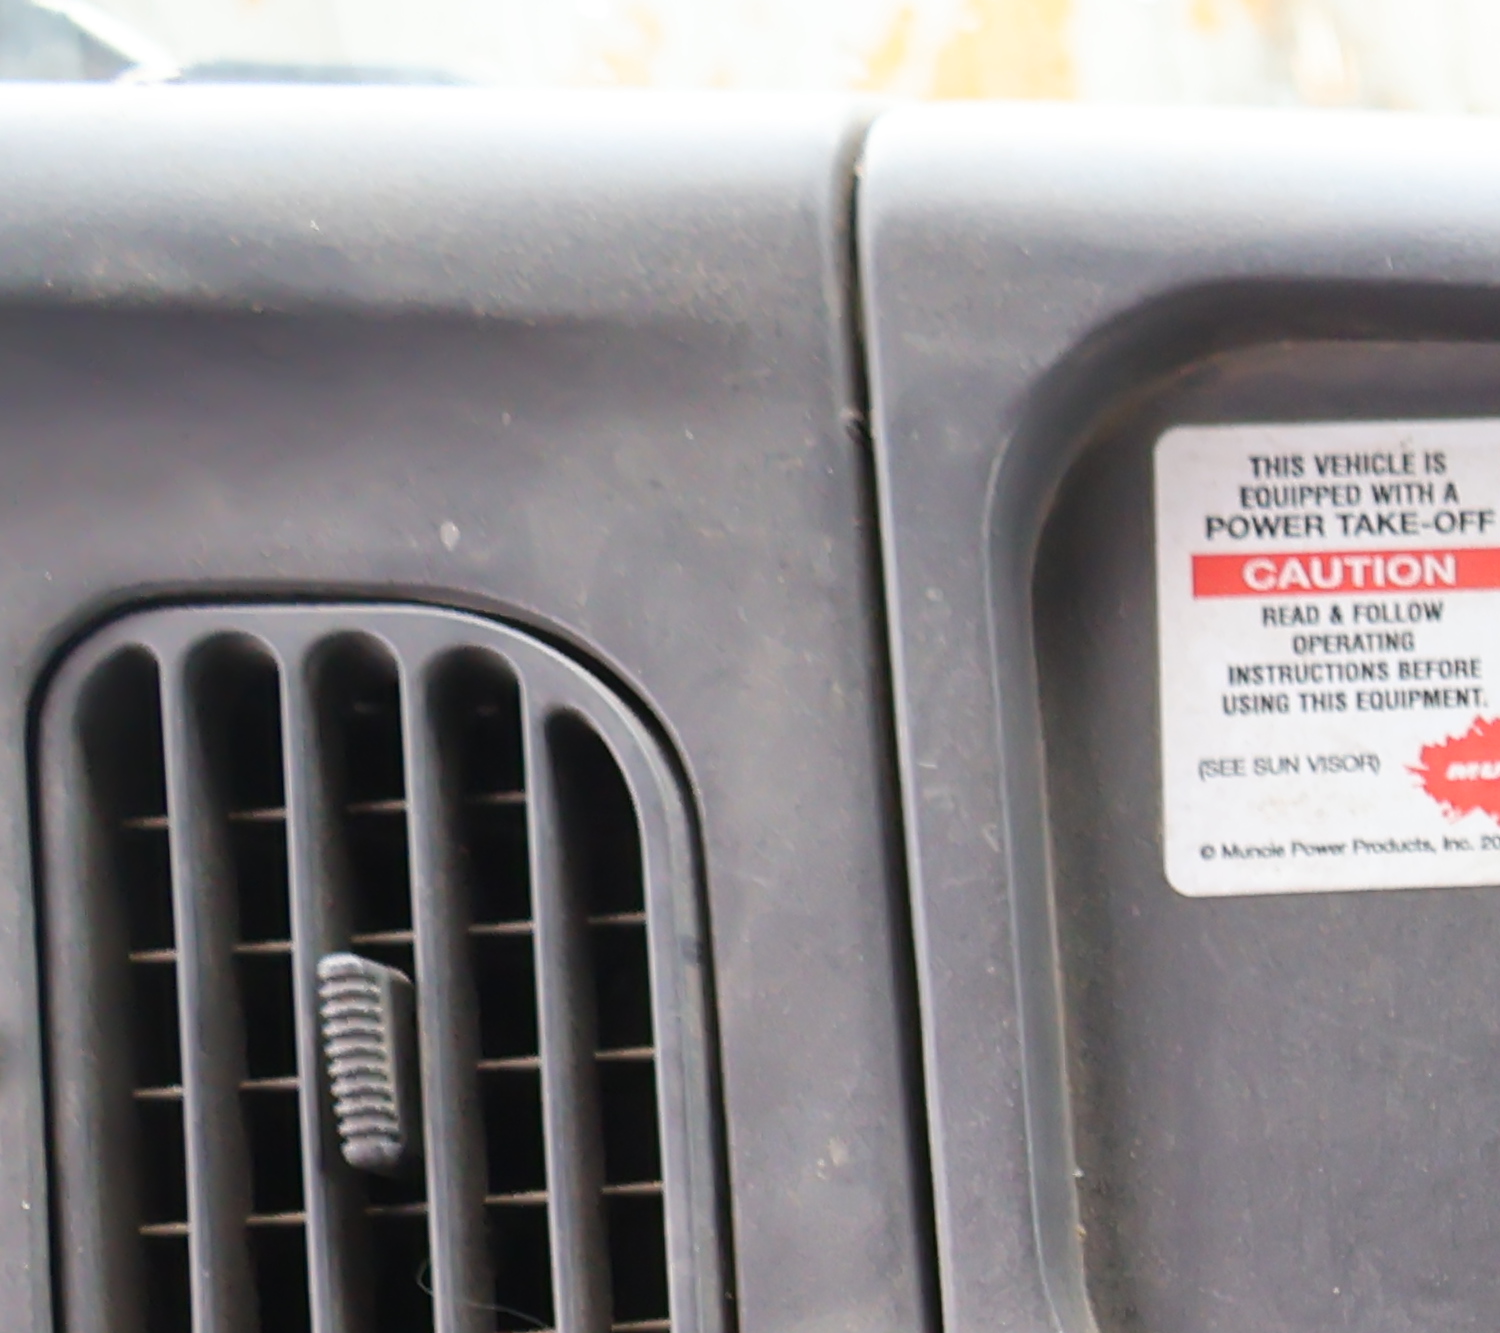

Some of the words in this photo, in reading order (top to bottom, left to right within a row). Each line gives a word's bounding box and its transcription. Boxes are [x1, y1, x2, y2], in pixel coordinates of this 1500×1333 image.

[1250, 454, 1304, 478] THIS
[1314, 452, 1416, 477] VEHICLE
[1424, 451, 1446, 473] IS
[1240, 484, 1361, 509] EQUIPPED
[1371, 482, 1433, 506] WITH
[1442, 482, 1459, 502] A
[1205, 515, 1326, 540] POWER
[1336, 510, 1496, 537] TAKE-OFF
[1242, 553, 1457, 591] CAUTION
[1261, 605, 1320, 627] READ
[1329, 605, 1343, 624] &
[1353, 601, 1443, 624] FOLLOW
[1293, 631, 1415, 655] OPERATING
[1228, 661, 1389, 686] INSTRUCTIONS
[1398, 657, 1482, 680] BEFORE
[1222, 692, 1290, 716] USING
[1299, 691, 1348, 712] THIS
[1356, 687, 1488, 711] EQUIPMENT.
[1197, 756, 1247, 781] (SEE
[1253, 755, 1301, 776] SUN
[1306, 753, 1382, 776] VISOR)
[1222, 841, 1286, 860] Muncie
[1290, 840, 1346, 859] Power
[1352, 836, 1437, 857] Products,
[1442, 836, 1474, 853] Inc.
